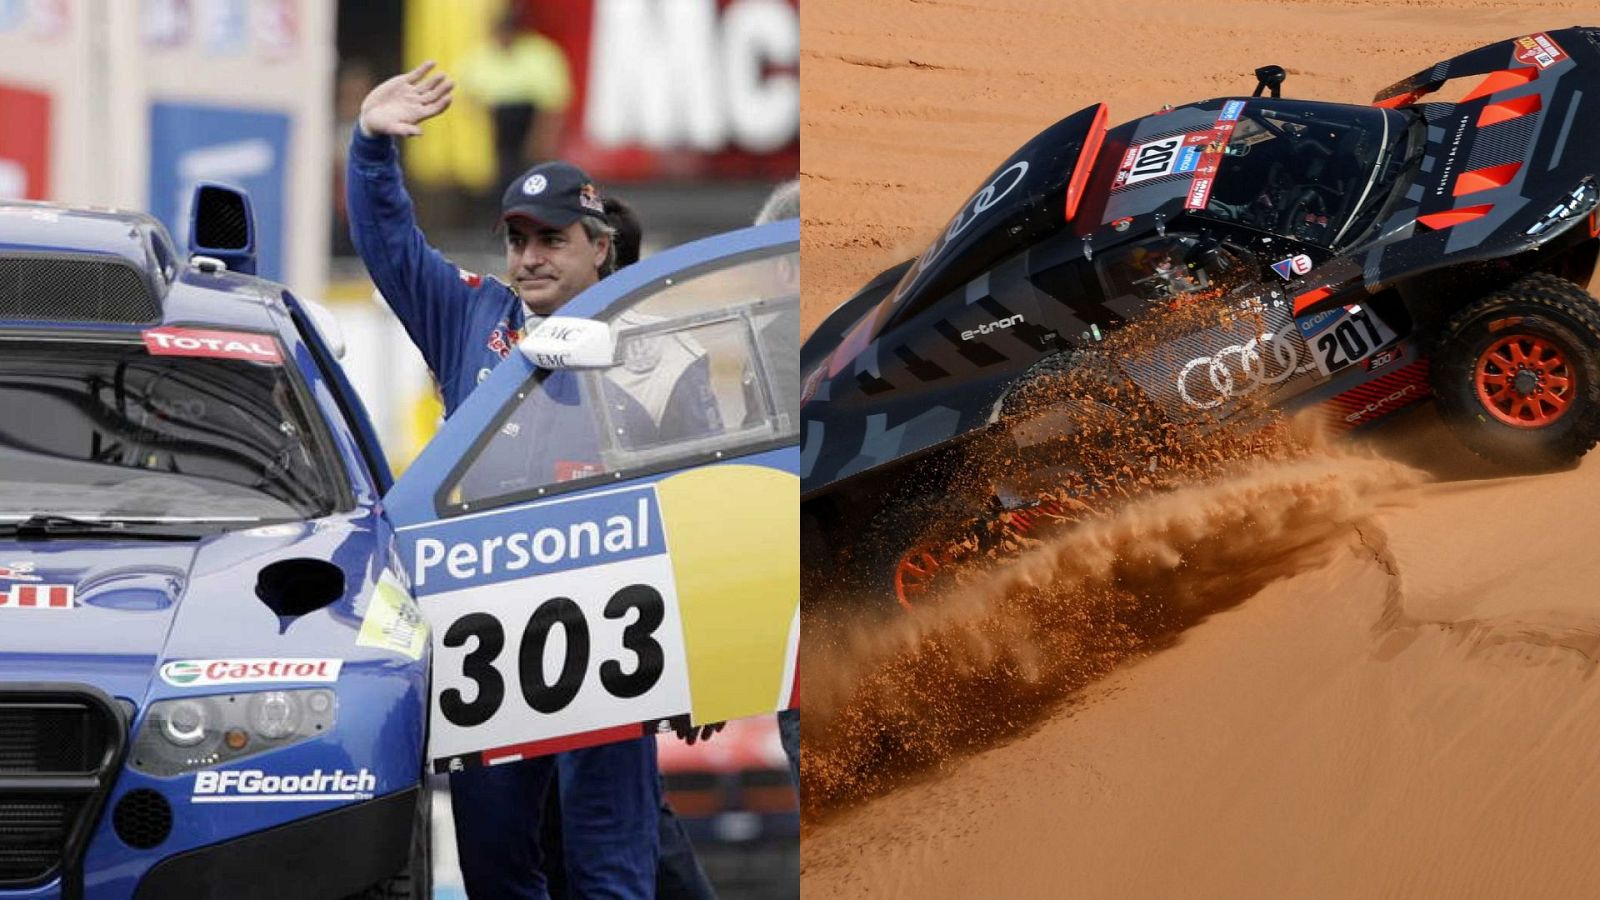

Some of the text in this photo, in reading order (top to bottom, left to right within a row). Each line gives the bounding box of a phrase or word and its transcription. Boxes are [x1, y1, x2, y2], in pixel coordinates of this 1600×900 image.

[1132, 140, 1178, 176] 207
[1190, 179, 1209, 206] MOTUL
[1295, 257, 1308, 272] E
[961, 314, 1025, 341] e-tron
[147, 332, 276, 356] TOTAL
[1317, 310, 1384, 373] 207
[1371, 353, 1392, 370] 300
[1345, 384, 1417, 422] e-tron
[414, 497, 649, 586] Personal
[439, 583, 665, 728] 303
[205, 661, 329, 680] Castrol
[193, 767, 376, 794] BFGoodrich
